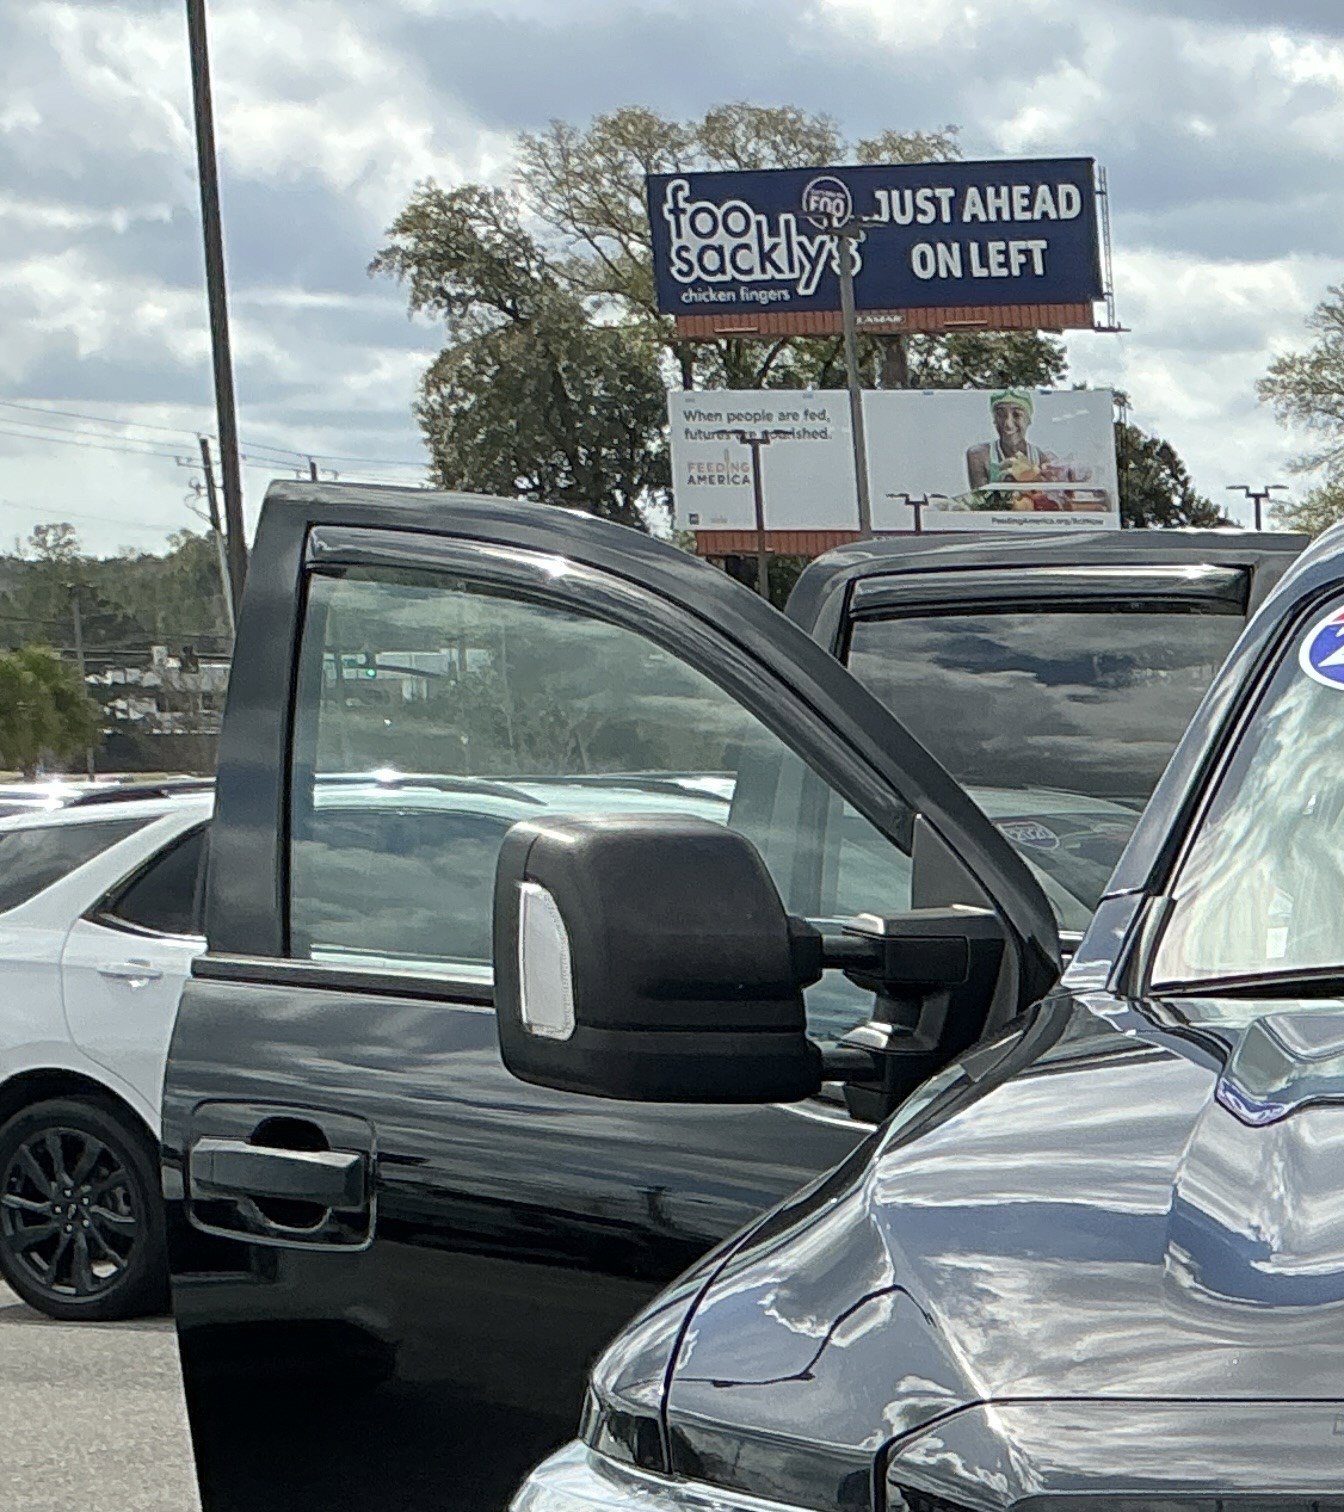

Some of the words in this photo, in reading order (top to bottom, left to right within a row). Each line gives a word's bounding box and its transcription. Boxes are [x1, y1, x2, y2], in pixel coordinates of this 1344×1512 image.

[664, 178, 757, 240] foo
[872, 186, 955, 226] JUST
[962, 183, 1083, 224] AHEAD
[911, 240, 963, 280] ON
[969, 238, 1049, 278] LEFT
[681, 286, 736, 304] chicken
[740, 284, 791, 305] fingers
[683, 409, 723, 422] When
[727, 408, 773, 424] people
[778, 411, 800, 421] are
[684, 427, 731, 441] futures
[687, 461, 750, 474] FEEDING
[687, 474, 751, 486] AMERICA
